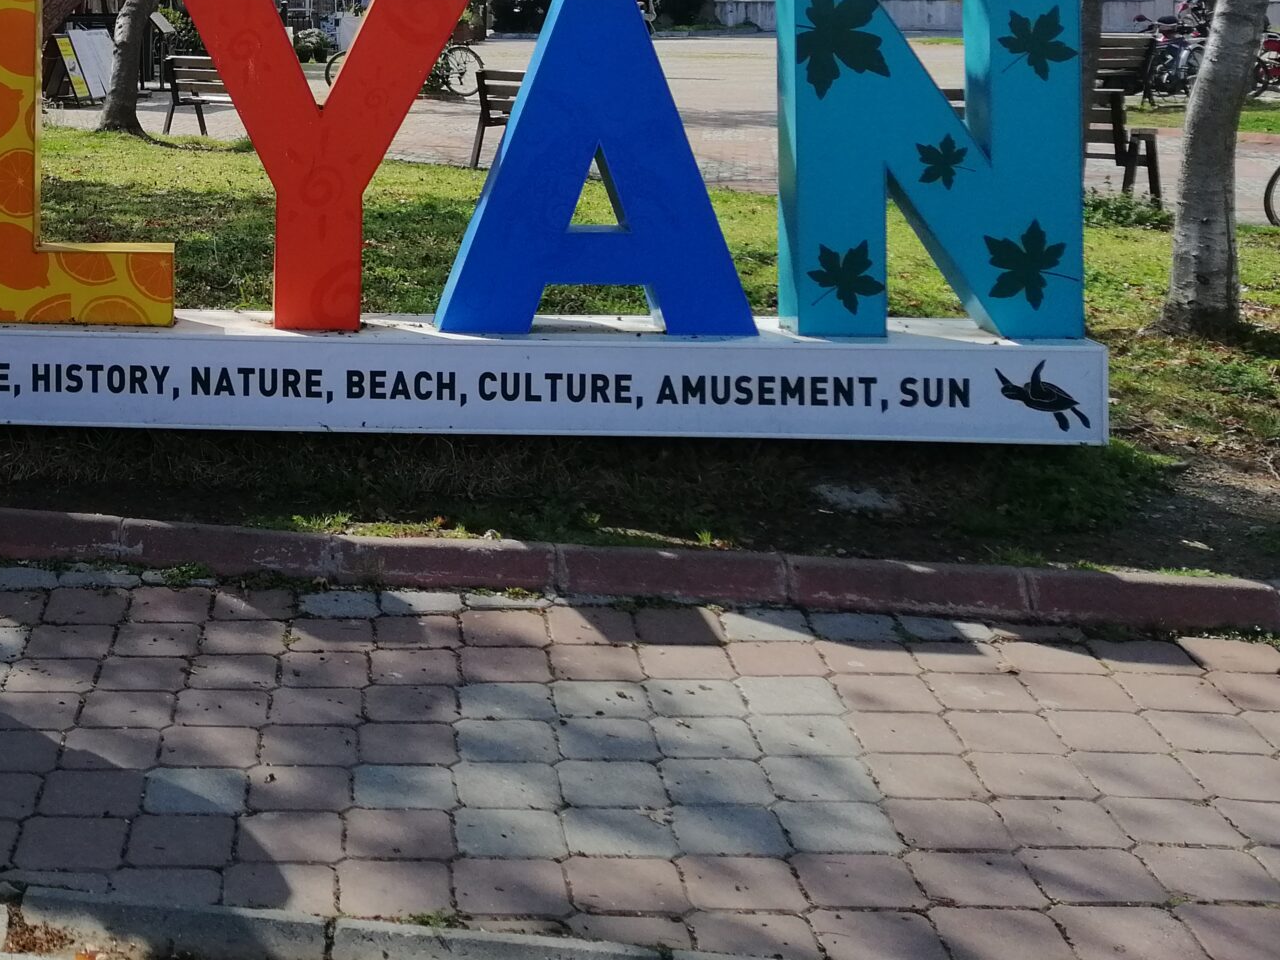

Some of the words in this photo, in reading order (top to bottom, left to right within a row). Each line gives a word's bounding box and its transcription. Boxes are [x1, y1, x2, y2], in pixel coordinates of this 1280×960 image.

[31, 363, 180, 401] HISTORY,
[191, 366, 334, 404] NATURE,
[346, 369, 467, 408] BEACH,
[478, 371, 644, 410] CULTURE,
[655, 374, 889, 413] AMUSEMENT,
[899, 376, 970, 408] SUN
